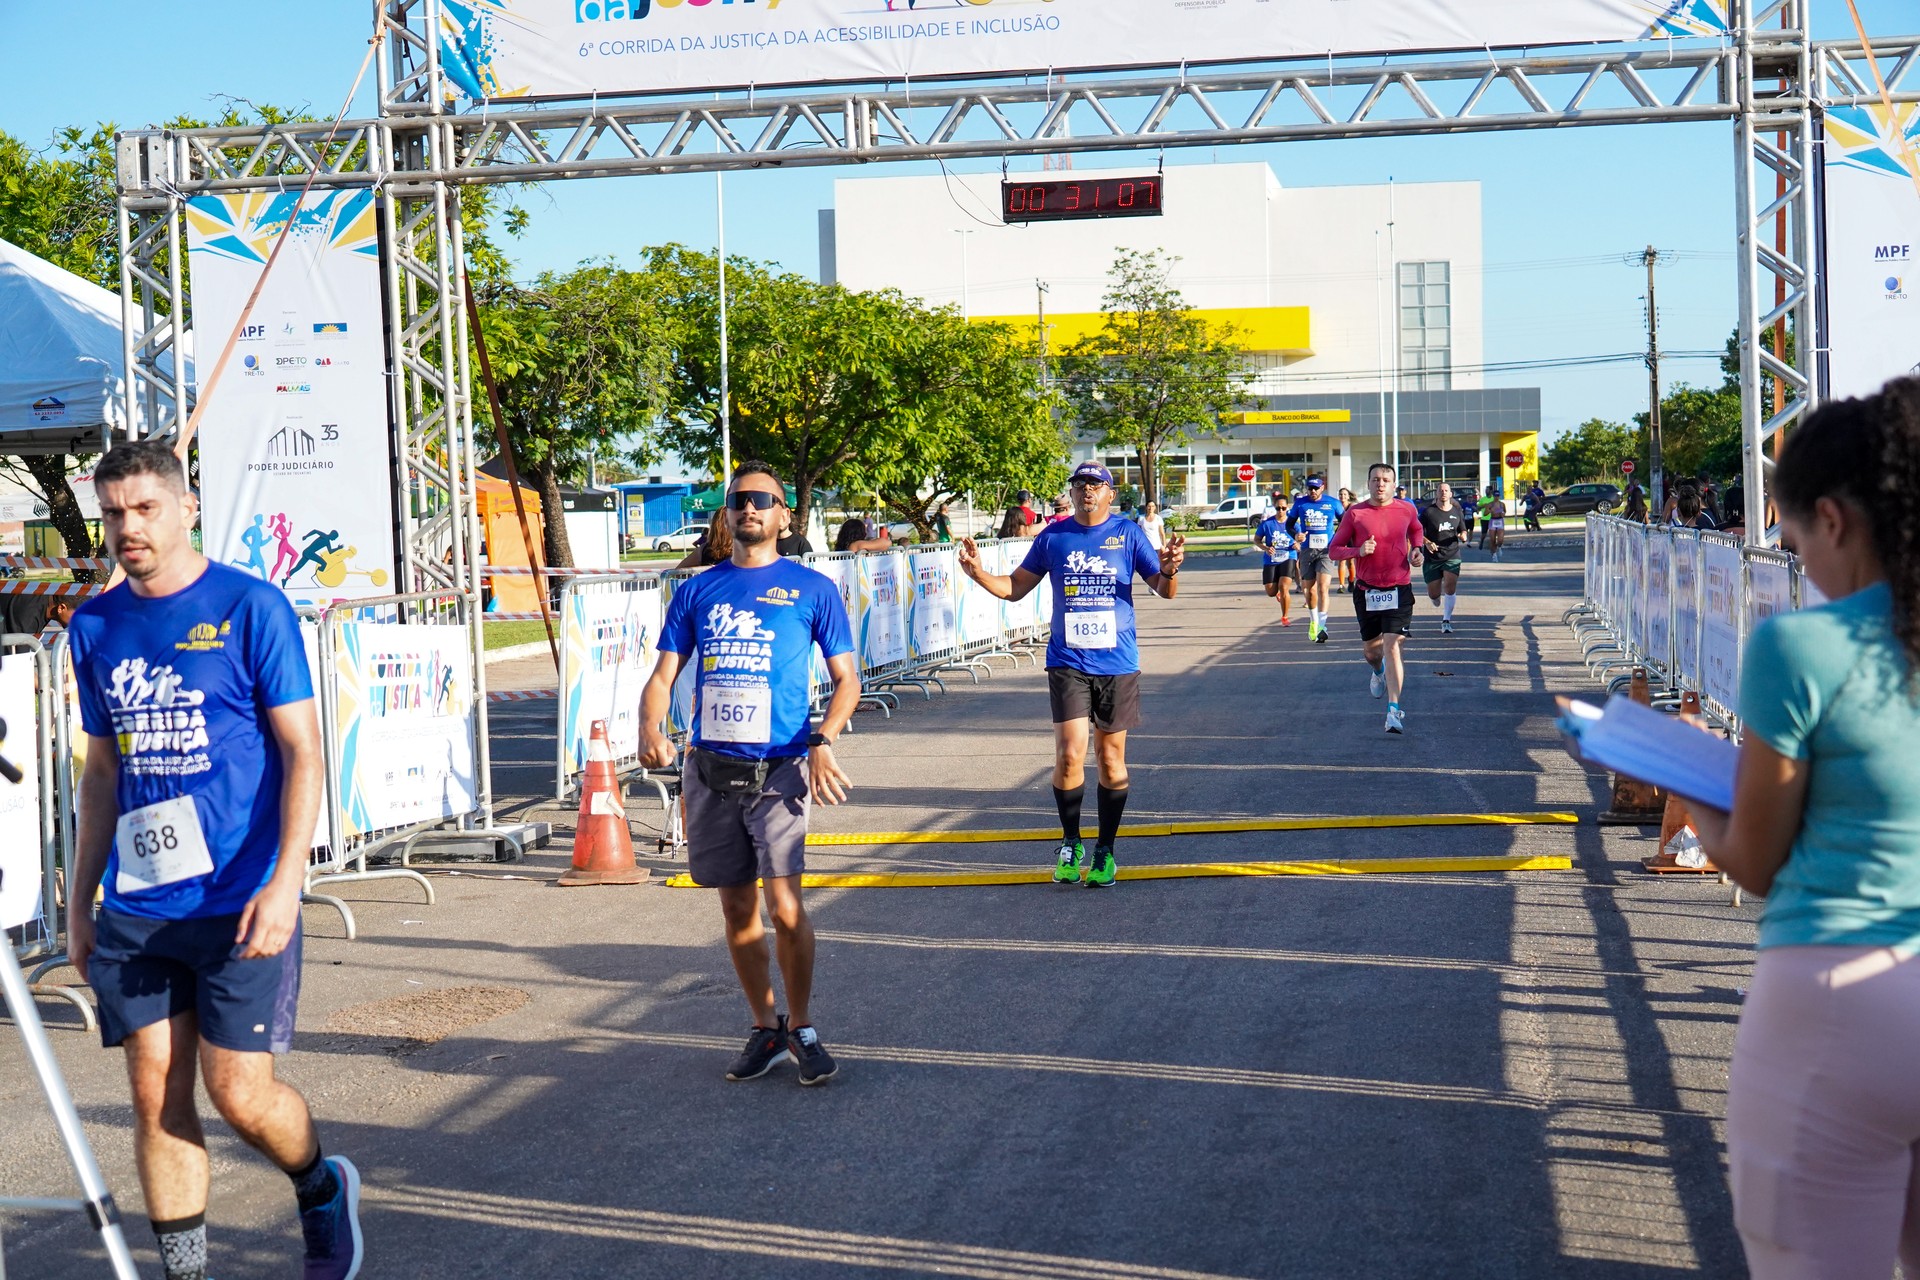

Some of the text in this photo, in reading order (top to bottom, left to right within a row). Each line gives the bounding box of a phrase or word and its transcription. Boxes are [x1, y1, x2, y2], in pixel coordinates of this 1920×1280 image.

[579, 13, 1060, 57] 6ª CORRIDA DA JUSTIÇA DA ACESSIBILIDADE E INCLUSÃO
[1010, 181, 1154, 212] 00 31 07
[1874, 244, 1910, 258] MPF
[276, 384, 311, 393] PALMAS
[1300, 413, 1320, 421] BRASIL
[321, 424, 339, 441] 35
[247, 459, 334, 472] PODER JUDICIÁRIO
[1063, 576, 1116, 586] CORRIDA
[1074, 585, 1116, 597] JUSTIÇA
[1370, 593, 1393, 603] 1909
[1073, 622, 1108, 636] 1834
[703, 641, 773, 657] CORRIDA
[369, 653, 422, 679] CORRIDA
[713, 655, 772, 673] JUSTIÇA
[382, 683, 421, 718] JUSTIÇA
[711, 703, 757, 723] 1567
[134, 825, 178, 858] 638
